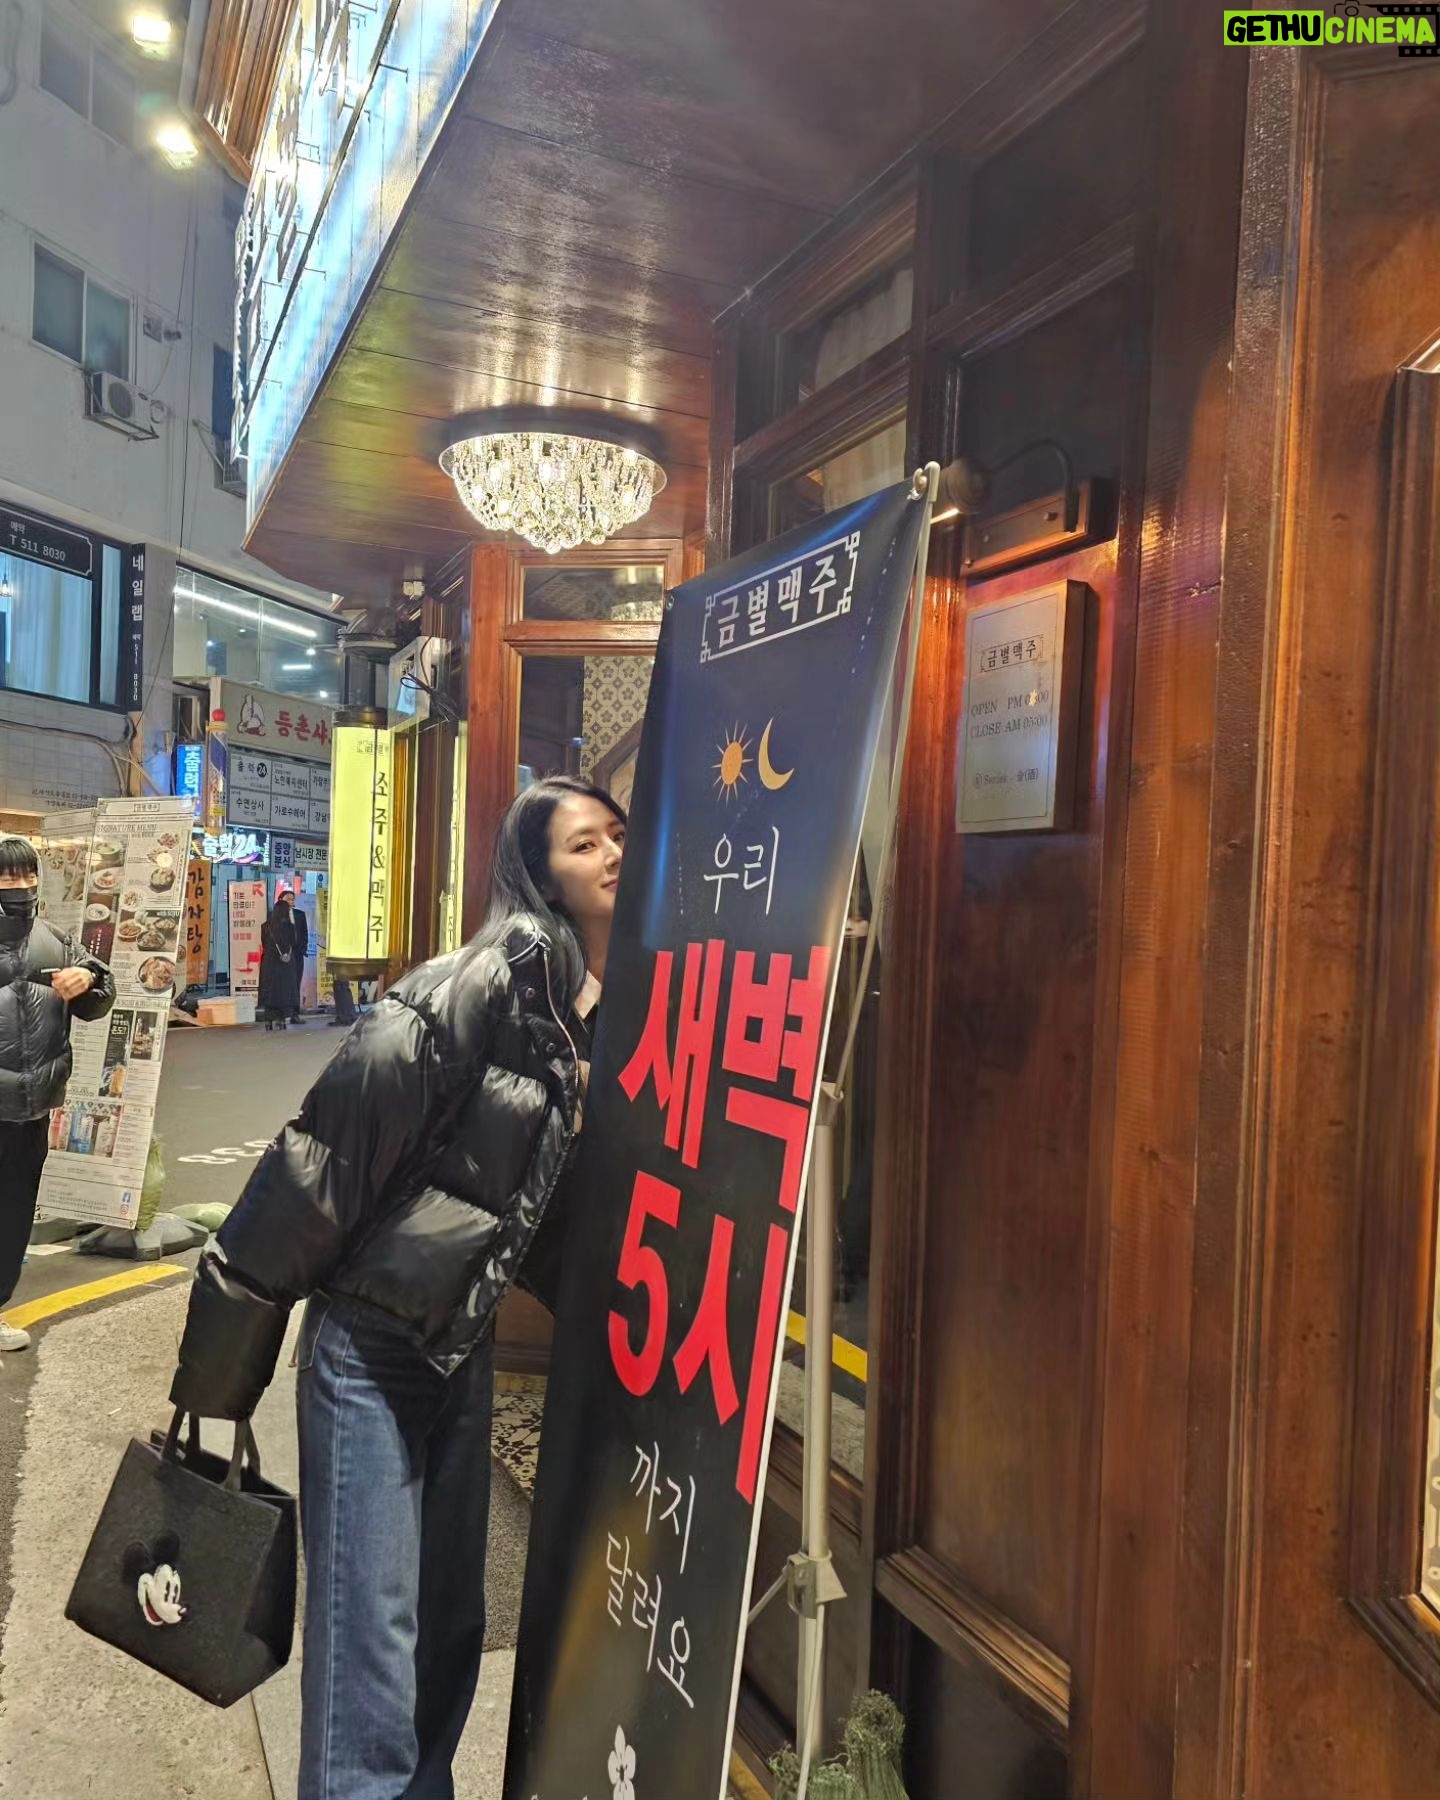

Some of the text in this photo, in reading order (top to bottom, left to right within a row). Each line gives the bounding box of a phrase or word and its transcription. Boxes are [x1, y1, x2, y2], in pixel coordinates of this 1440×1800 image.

[10, 535, 66, 562] T 511 8030
[131, 554, 144, 622] 네일랩
[716, 555, 838, 648] 금별맥주
[987, 639, 1037, 668] 금별맥주
[970, 722, 1002, 739] CLOSE
[1003, 718, 1021, 733] AM
[971, 700, 999, 718] OPEN
[1006, 695, 1023, 710] PM
[703, 826, 781, 916] 우리
[617, 938, 832, 1214] 새벽
[608, 1170, 787, 1504] 5시
[630, 1441, 696, 1575] 까지
[606, 1531, 695, 1708] 달려요
